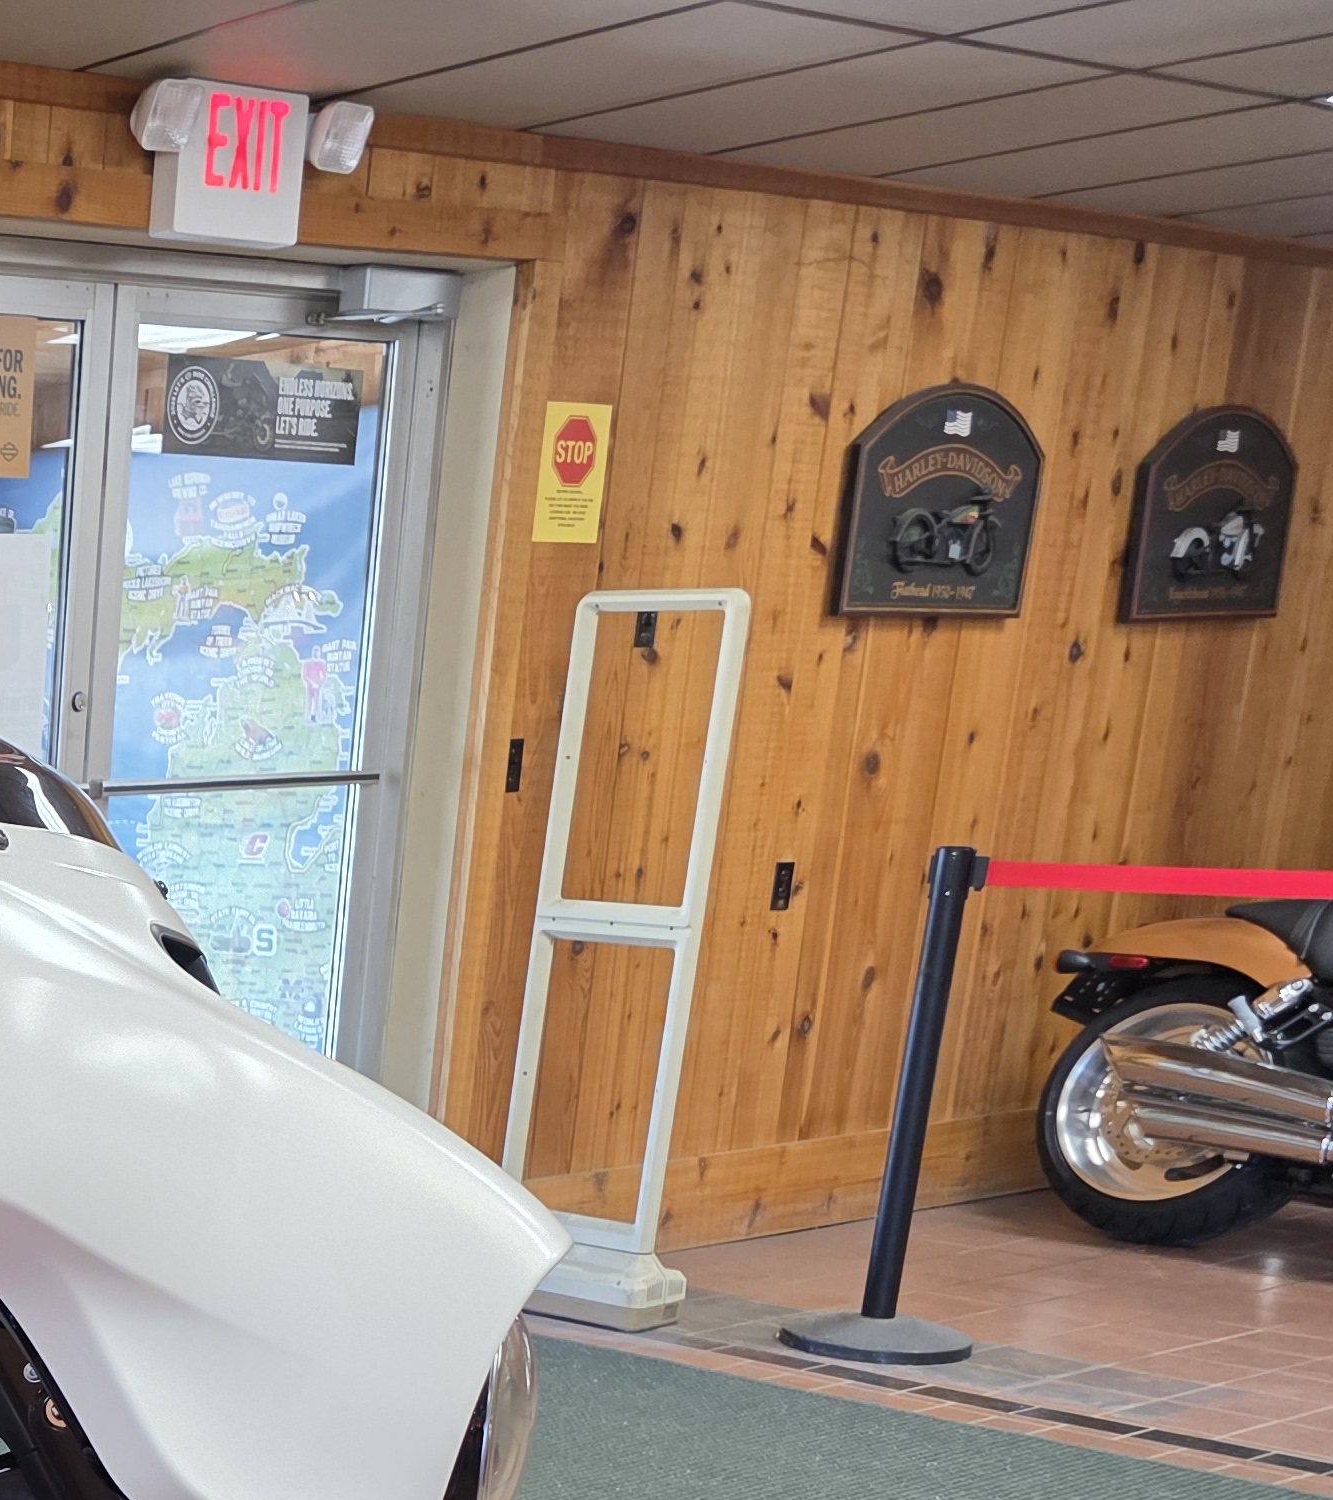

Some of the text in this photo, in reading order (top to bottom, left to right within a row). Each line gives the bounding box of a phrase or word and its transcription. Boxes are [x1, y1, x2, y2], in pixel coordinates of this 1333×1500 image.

[205, 93, 290, 194] EXIT
[279, 377, 313, 398] ENDLESS
[0, 402, 21, 417] RIDE.
[277, 396, 332, 418] ONE PURPOSE.
[275, 417, 318, 437] LET'S RIDE.
[556, 440, 593, 464] STOP
[894, 452, 1006, 496] HARLEY-DAVIDSON
